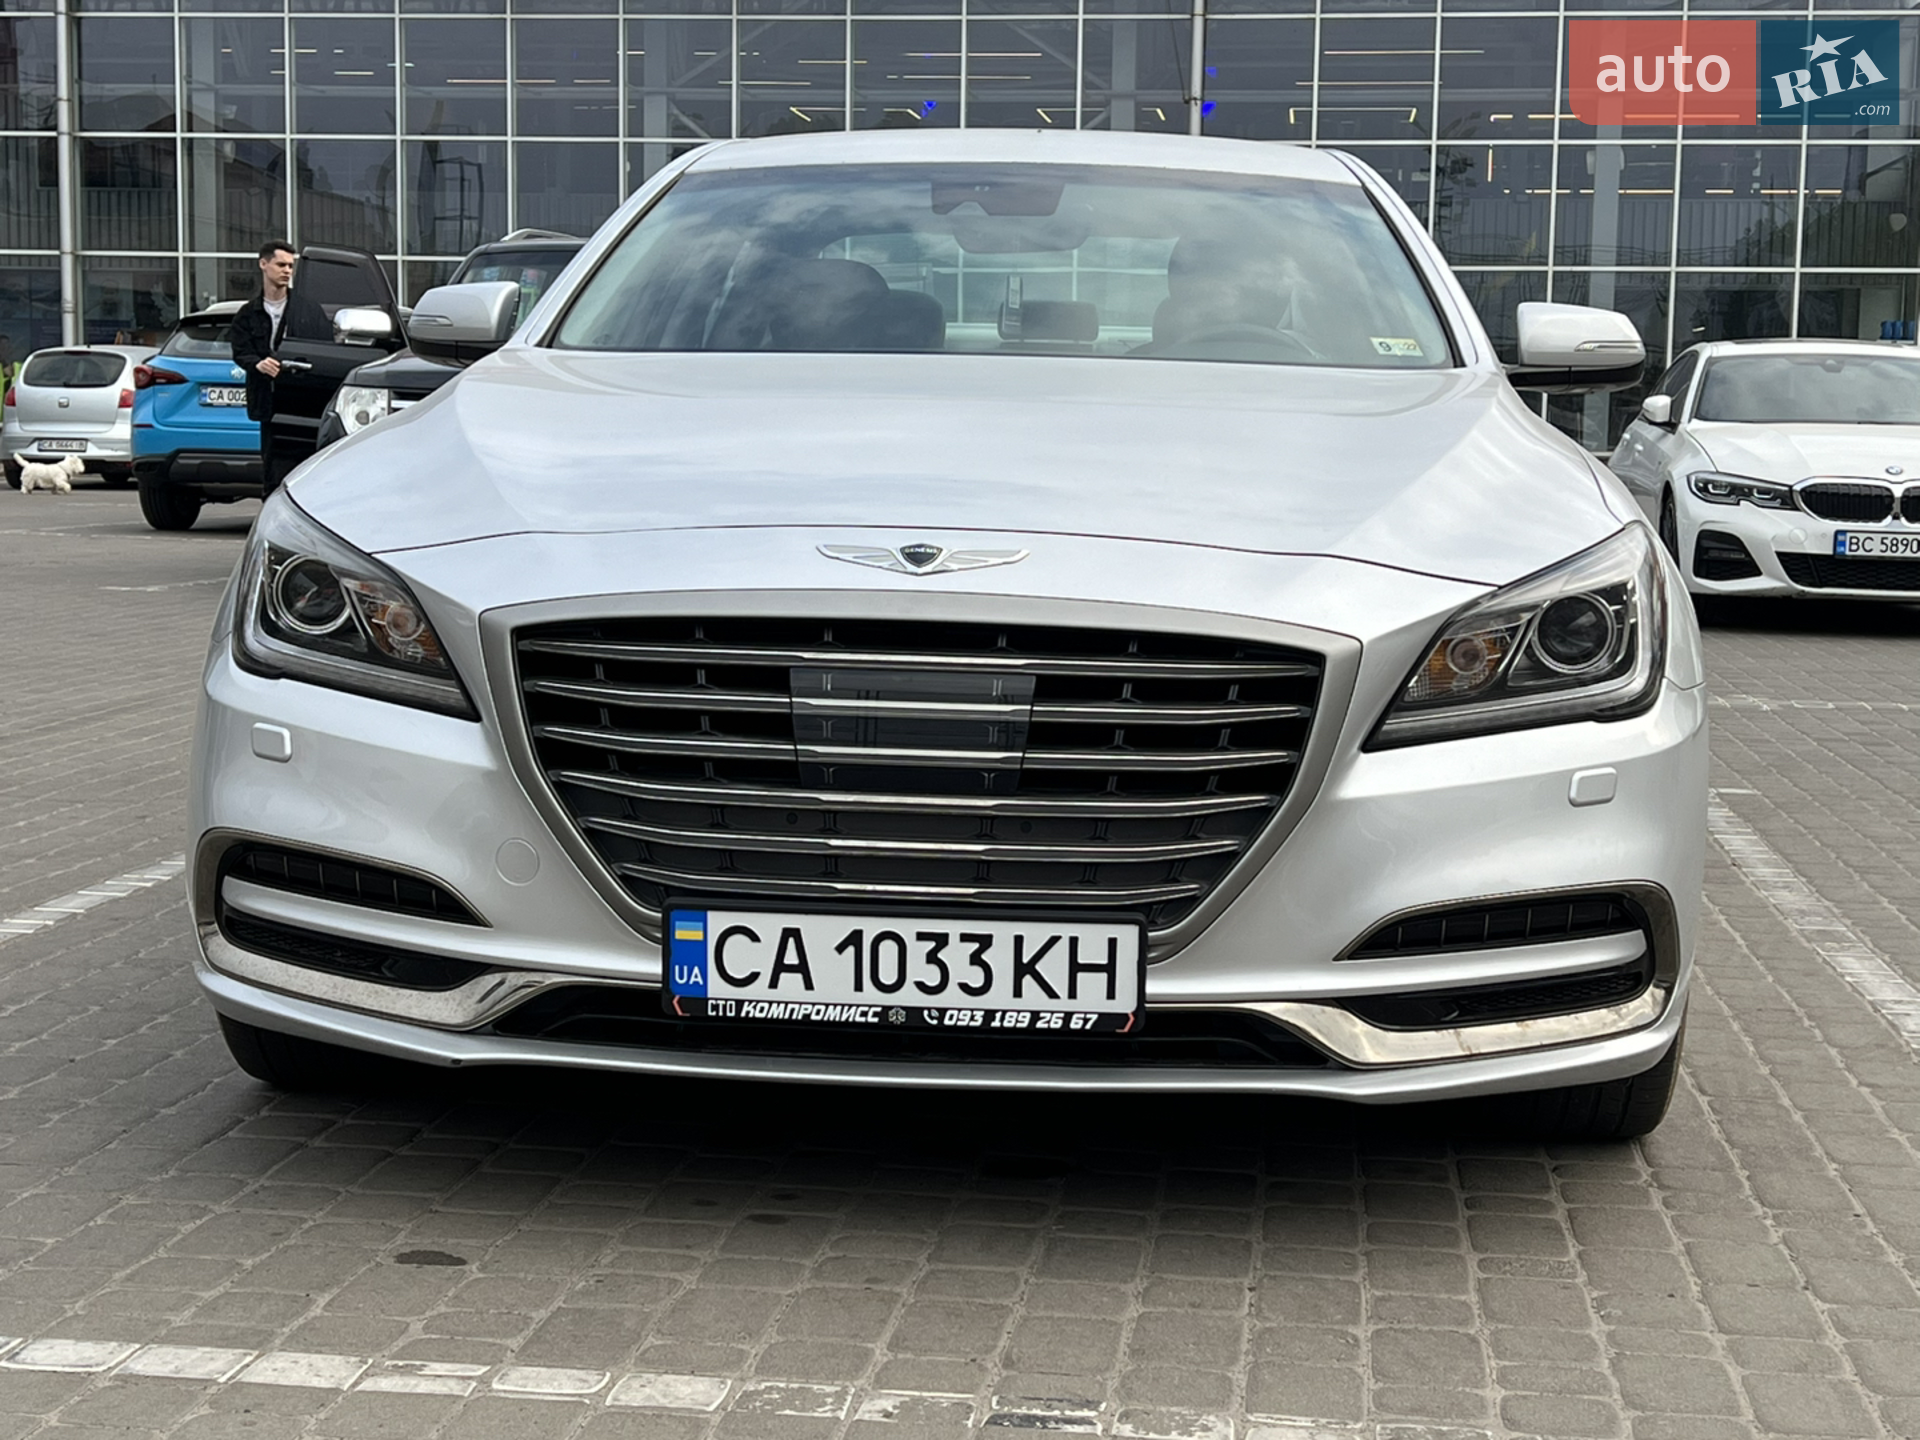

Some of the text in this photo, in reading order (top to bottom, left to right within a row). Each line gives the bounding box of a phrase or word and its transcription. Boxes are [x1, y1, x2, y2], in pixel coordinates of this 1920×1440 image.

[208, 389, 225, 401] CA
[1848, 536, 1874, 553] BC
[1880, 537, 1920, 554] 5890
[713, 924, 1118, 1000] CA 1033 KH
[674, 964, 704, 986] UA
[740, 1000, 882, 1023] КОМПРОМИСС
[943, 1009, 985, 1027] 093
[990, 1011, 1031, 1029] 189
[1035, 1012, 1065, 1029] 26
[1069, 1013, 1099, 1030] 67
